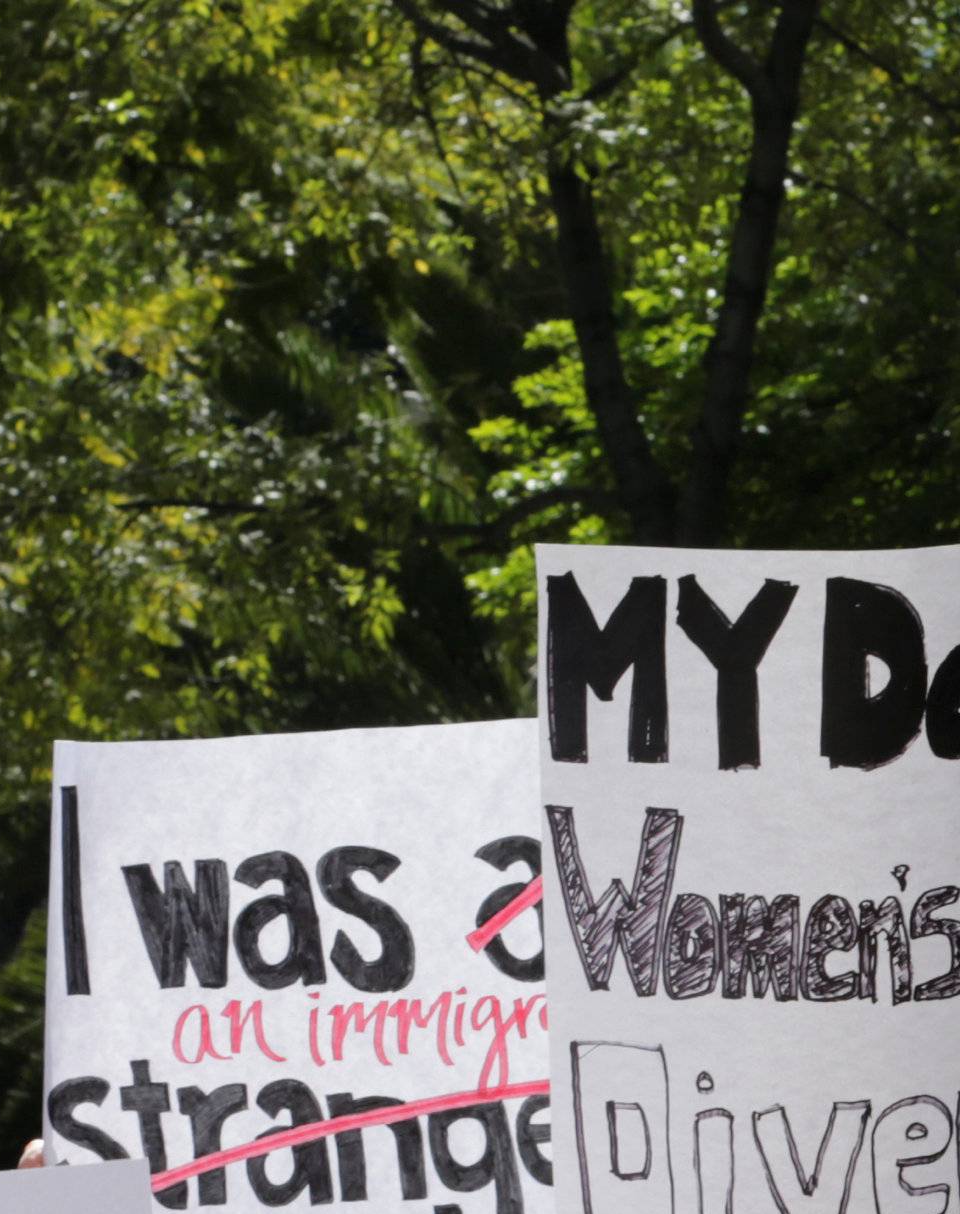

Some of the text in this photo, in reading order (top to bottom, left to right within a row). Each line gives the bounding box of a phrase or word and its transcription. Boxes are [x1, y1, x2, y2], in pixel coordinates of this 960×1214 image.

[546, 571, 799, 772] MY
[60, 785, 91, 995] I
[122, 845, 415, 993] was
[544, 805, 960, 1006] Women's
[172, 999, 287, 1063] an
